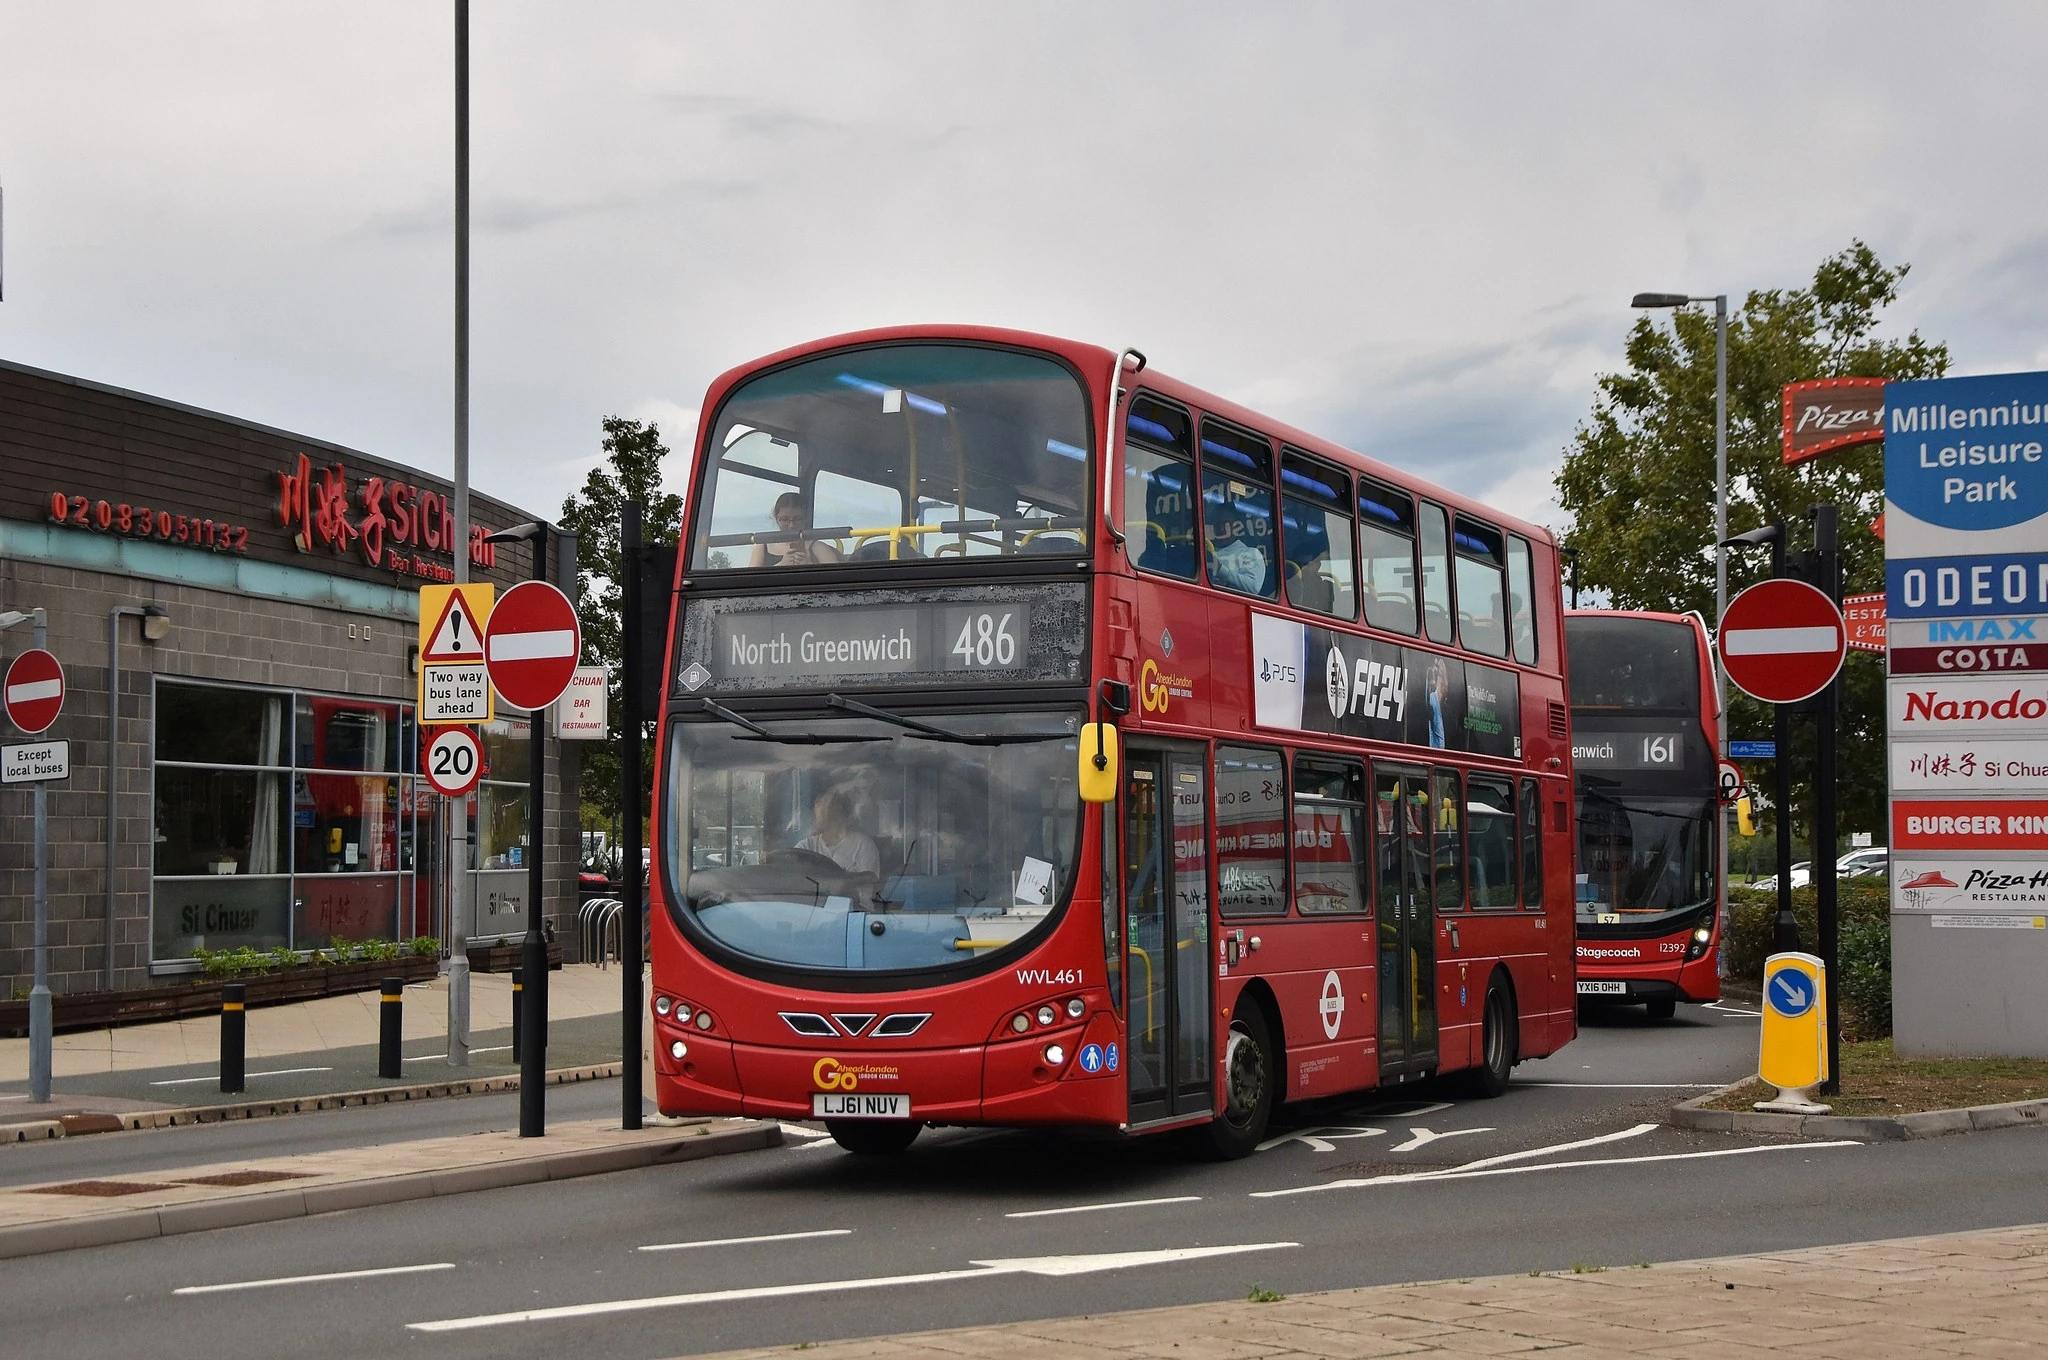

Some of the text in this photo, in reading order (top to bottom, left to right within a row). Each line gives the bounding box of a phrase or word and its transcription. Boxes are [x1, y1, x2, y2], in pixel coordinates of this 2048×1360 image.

[1796, 404, 1871, 434] Pizza
[1919, 440, 2043, 468] Leisure
[1943, 475, 2017, 504] Park
[52, 491, 248, 552] 02083051132
[388, 549, 454, 584] Bar Restaur
[732, 613, 1016, 666] North Greenwich 486
[1856, 624, 1867, 638] &
[1928, 619, 2037, 643] IMAX
[1937, 647, 2030, 671] COSTA
[430, 671, 482, 684] Two way
[572, 676, 603, 686] CHUAN
[1155, 672, 1193, 688] Ahead-London
[1272, 663, 1296, 683] PS5
[430, 687, 482, 699] bus lane
[1141, 658, 1169, 714] Go
[437, 702, 474, 713] ahead
[573, 699, 591, 708] BAR
[1903, 688, 2048, 722] Nando
[562, 722, 602, 730] RESTAURANT
[17, 748, 52, 761] Except
[1571, 736, 1674, 763] enwich 161
[434, 745, 474, 775] 20
[1910, 752, 1977, 778] 川妹子
[1984, 761, 2000, 777] Si
[6, 764, 63, 777] local buses
[1907, 816, 2002, 835] BURGER
[1964, 869, 2026, 890] Pizza
[1972, 893, 2048, 902] RESTAURAN
[1239, 944, 1247, 958] BX
[1576, 946, 1641, 959] Stagecoach
[1659, 943, 1686, 953] 12392
[1016, 969, 1083, 985] WVL461
[1578, 983, 1620, 992] YX16 OHH
[813, 1057, 858, 1090] Go
[837, 1064, 898, 1073] Ahead-London
[824, 1096, 898, 1114] LJ61 NUV
